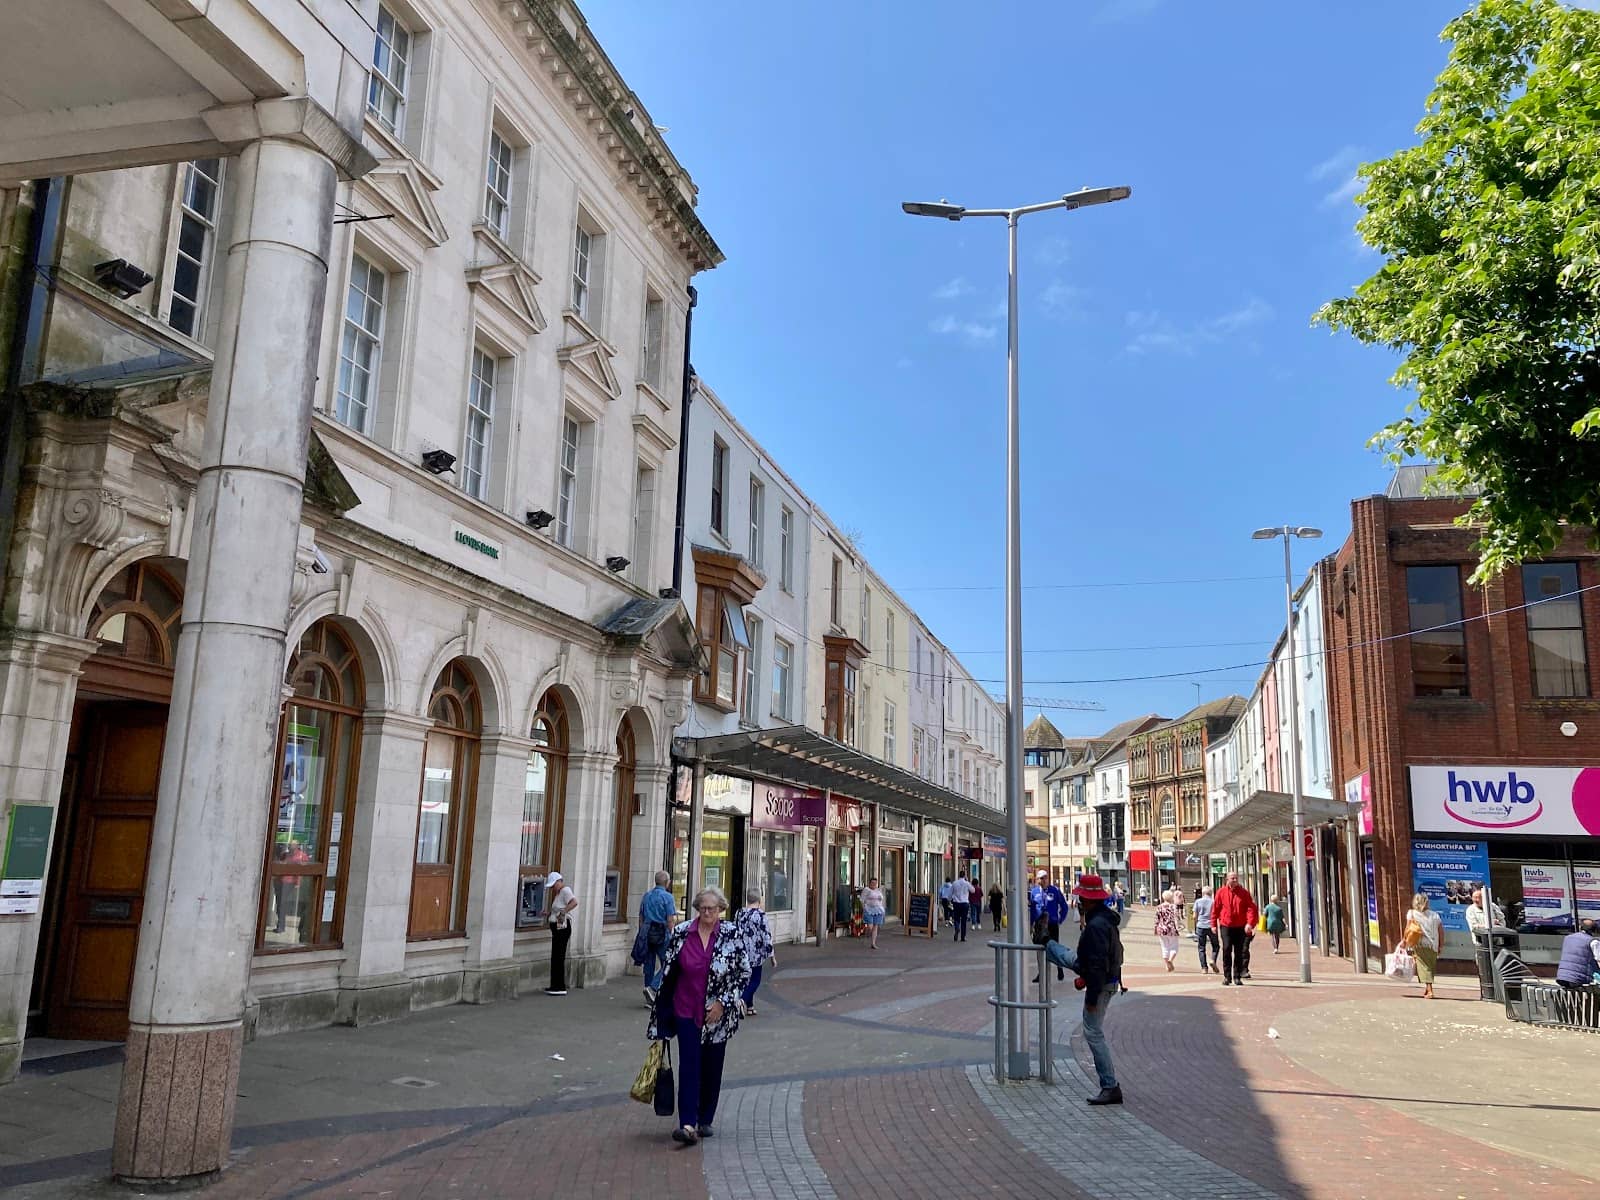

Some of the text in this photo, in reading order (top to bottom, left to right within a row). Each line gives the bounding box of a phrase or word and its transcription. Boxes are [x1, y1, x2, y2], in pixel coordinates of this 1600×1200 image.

[455, 531, 499, 560] LLOYDS BANK
[1447, 770, 1535, 804] hwb
[765, 790, 794, 822] Scope
[802, 815, 824, 824] Scope
[1524, 868, 1544, 876] hwb
